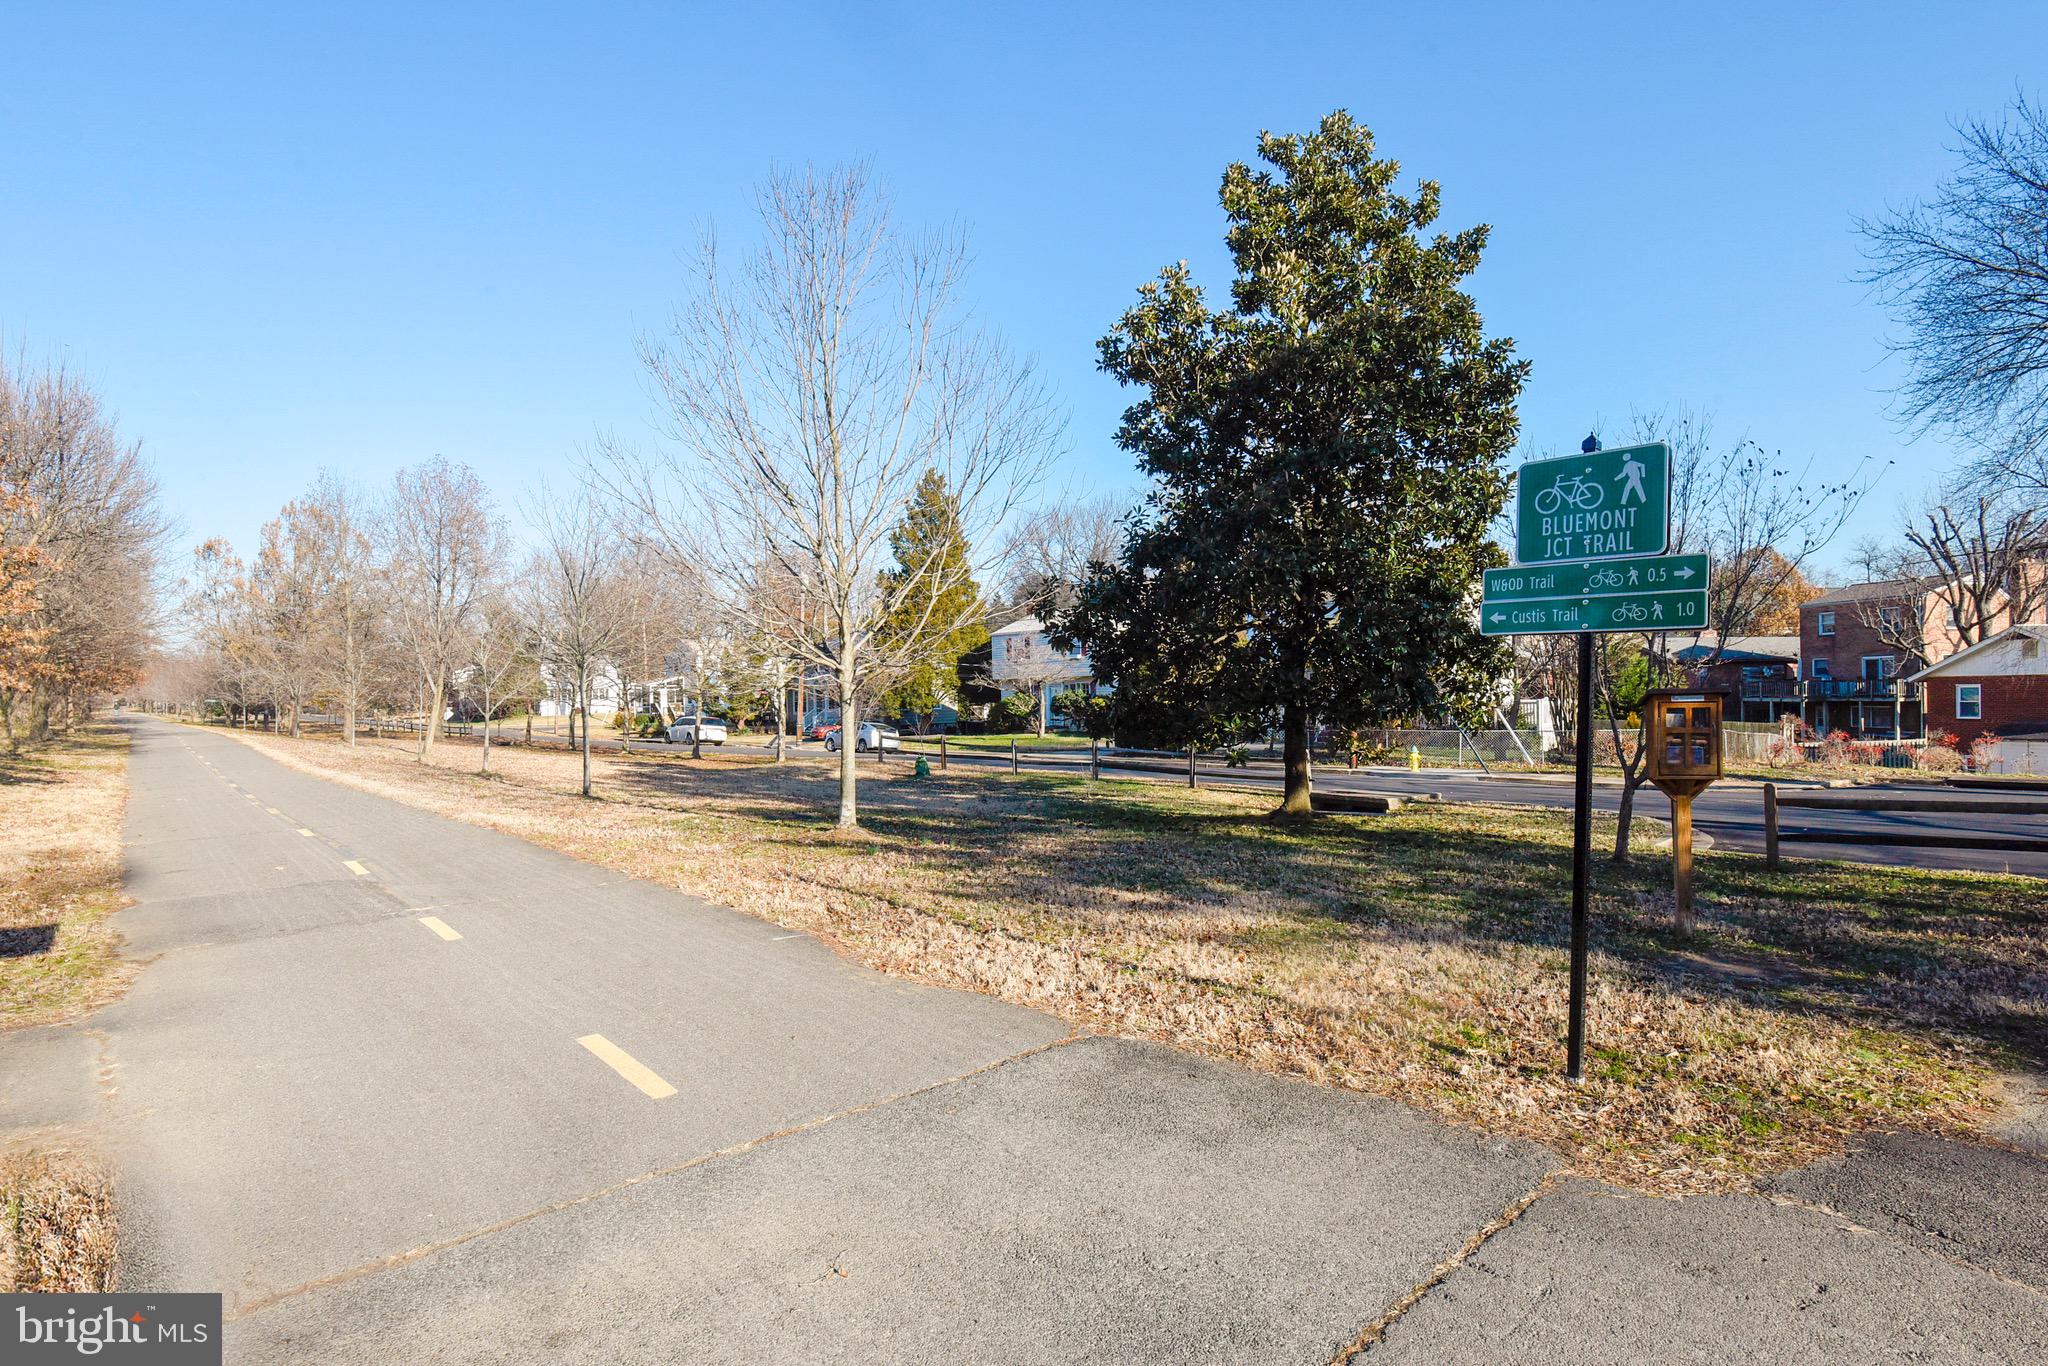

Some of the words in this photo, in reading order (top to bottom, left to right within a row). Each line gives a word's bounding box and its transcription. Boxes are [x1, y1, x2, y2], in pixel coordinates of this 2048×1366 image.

[1541, 507, 1638, 536] BLUEMONT
[1544, 536, 1572, 558] JCT
[1583, 530, 1634, 554] TRAIL
[1491, 577, 1523, 592] W&OD
[1530, 574, 1555, 589] Trail
[1647, 567, 1667, 582] 0.5
[1511, 611, 1546, 624] Custis
[1552, 607, 1579, 622] Trail
[1676, 602, 1695, 617] 1.0
